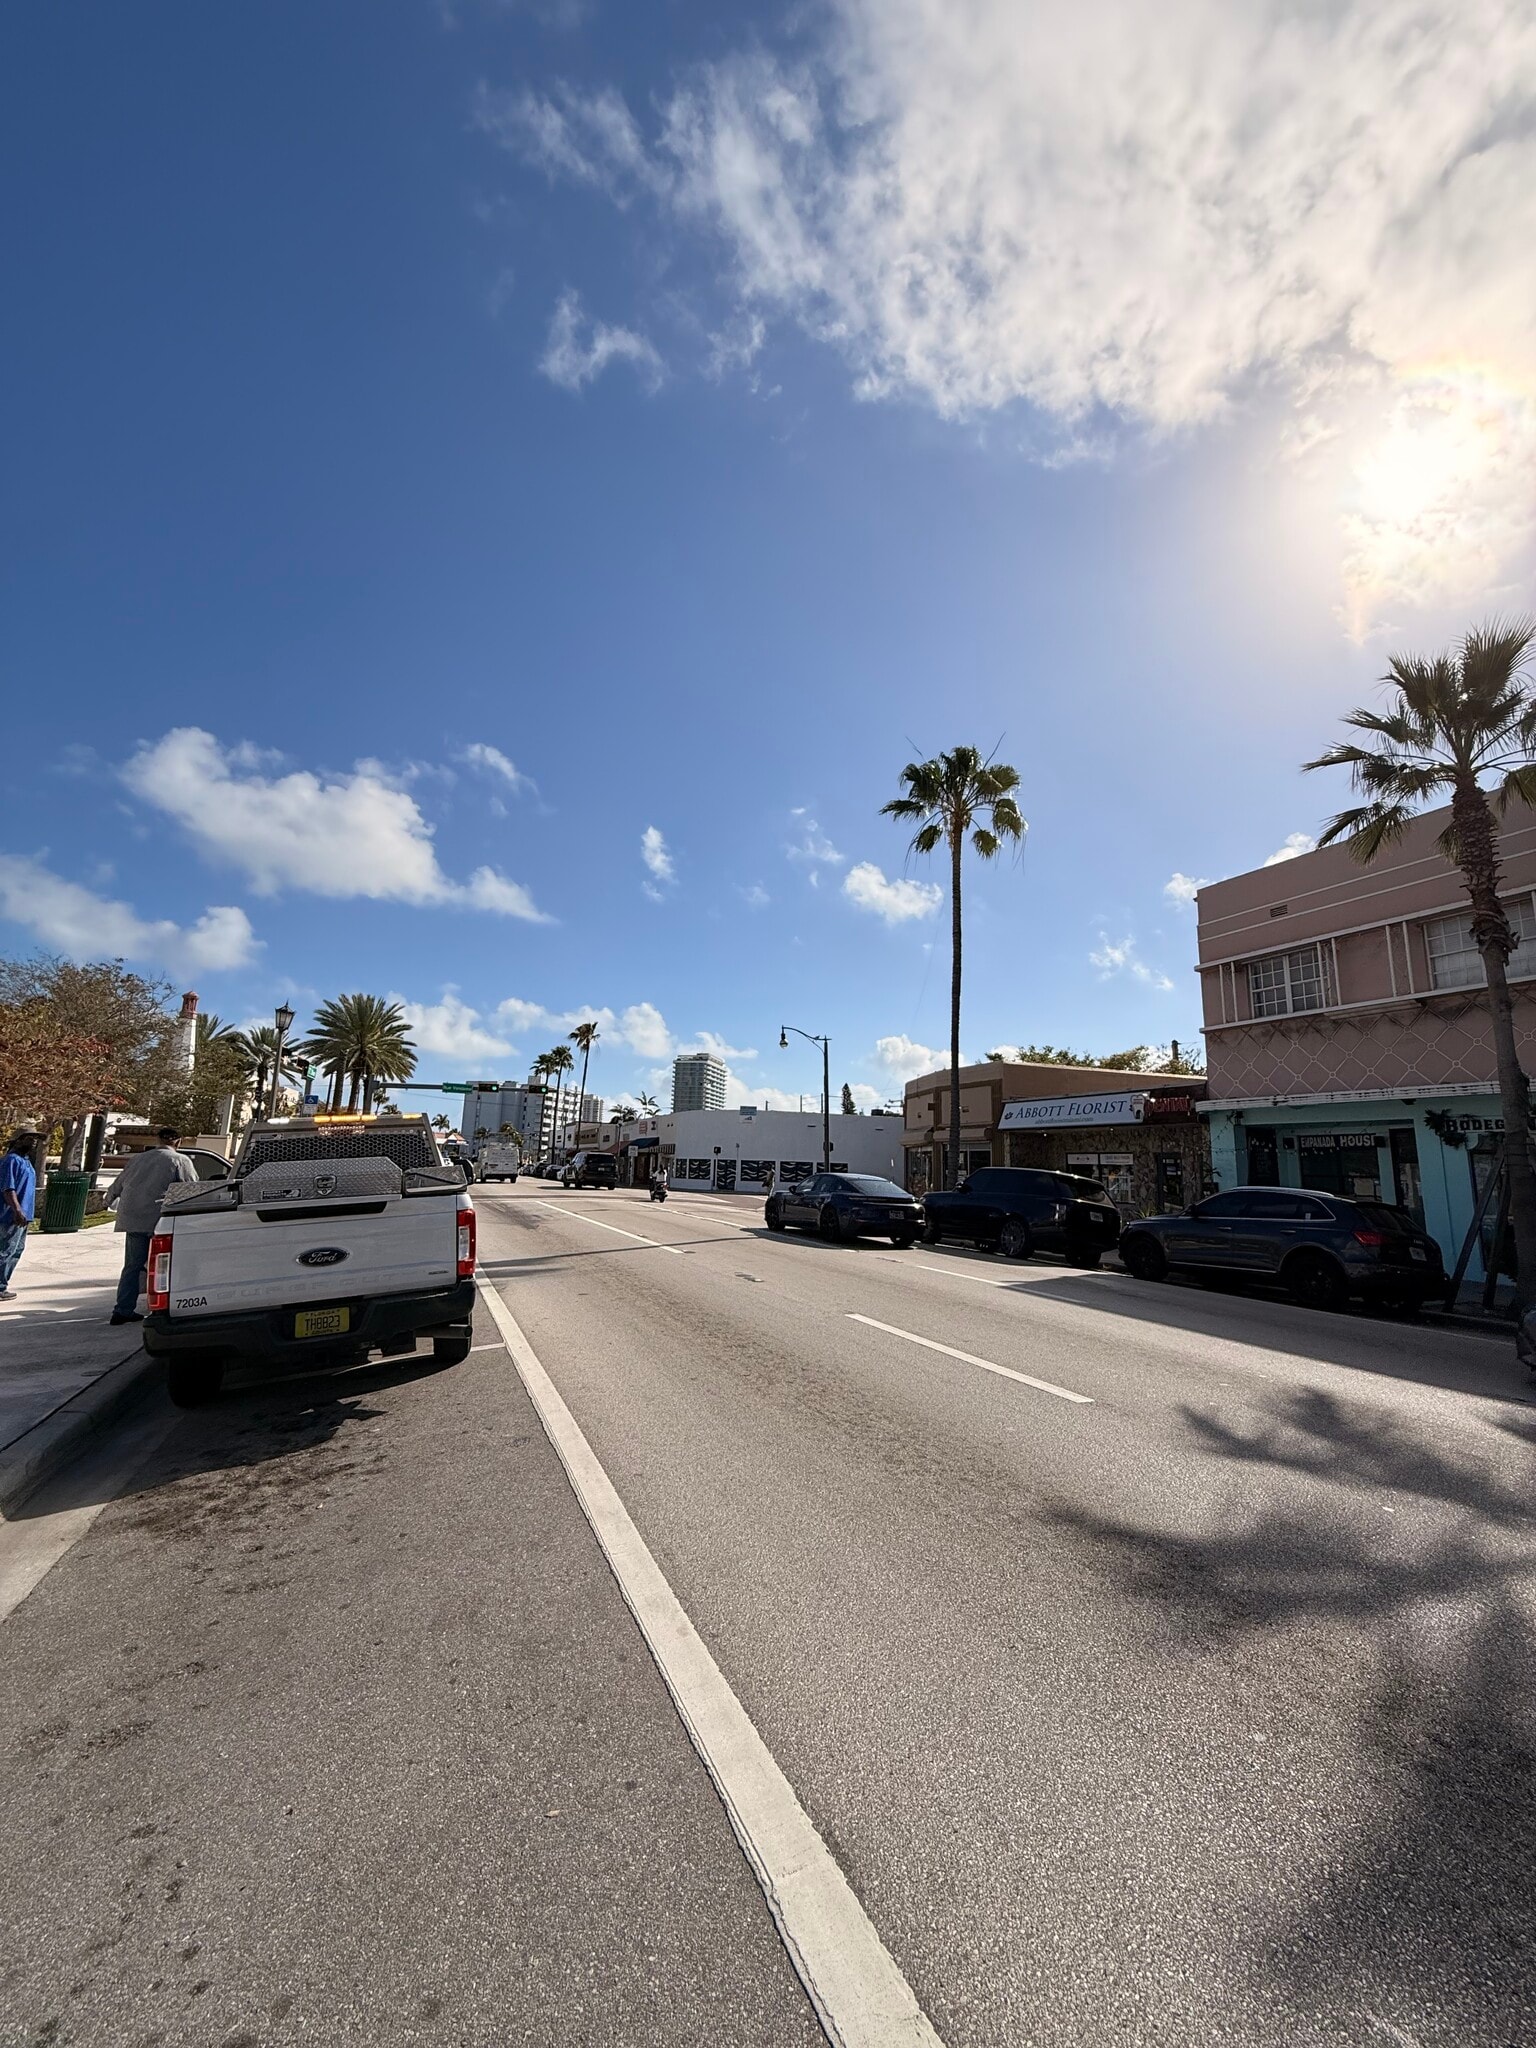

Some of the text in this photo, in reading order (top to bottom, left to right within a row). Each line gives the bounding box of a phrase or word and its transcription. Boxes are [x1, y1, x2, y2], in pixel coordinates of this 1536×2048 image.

[1015, 1105, 1065, 1119] ABBOTT
[1067, 1100, 1127, 1116] FLORIST
[1446, 1119, 1505, 1131] BODEG
[1300, 1136, 1336, 1148] EMPANADA
[309, 1251, 338, 1264] Ford
[175, 1296, 208, 1309] 7203A
